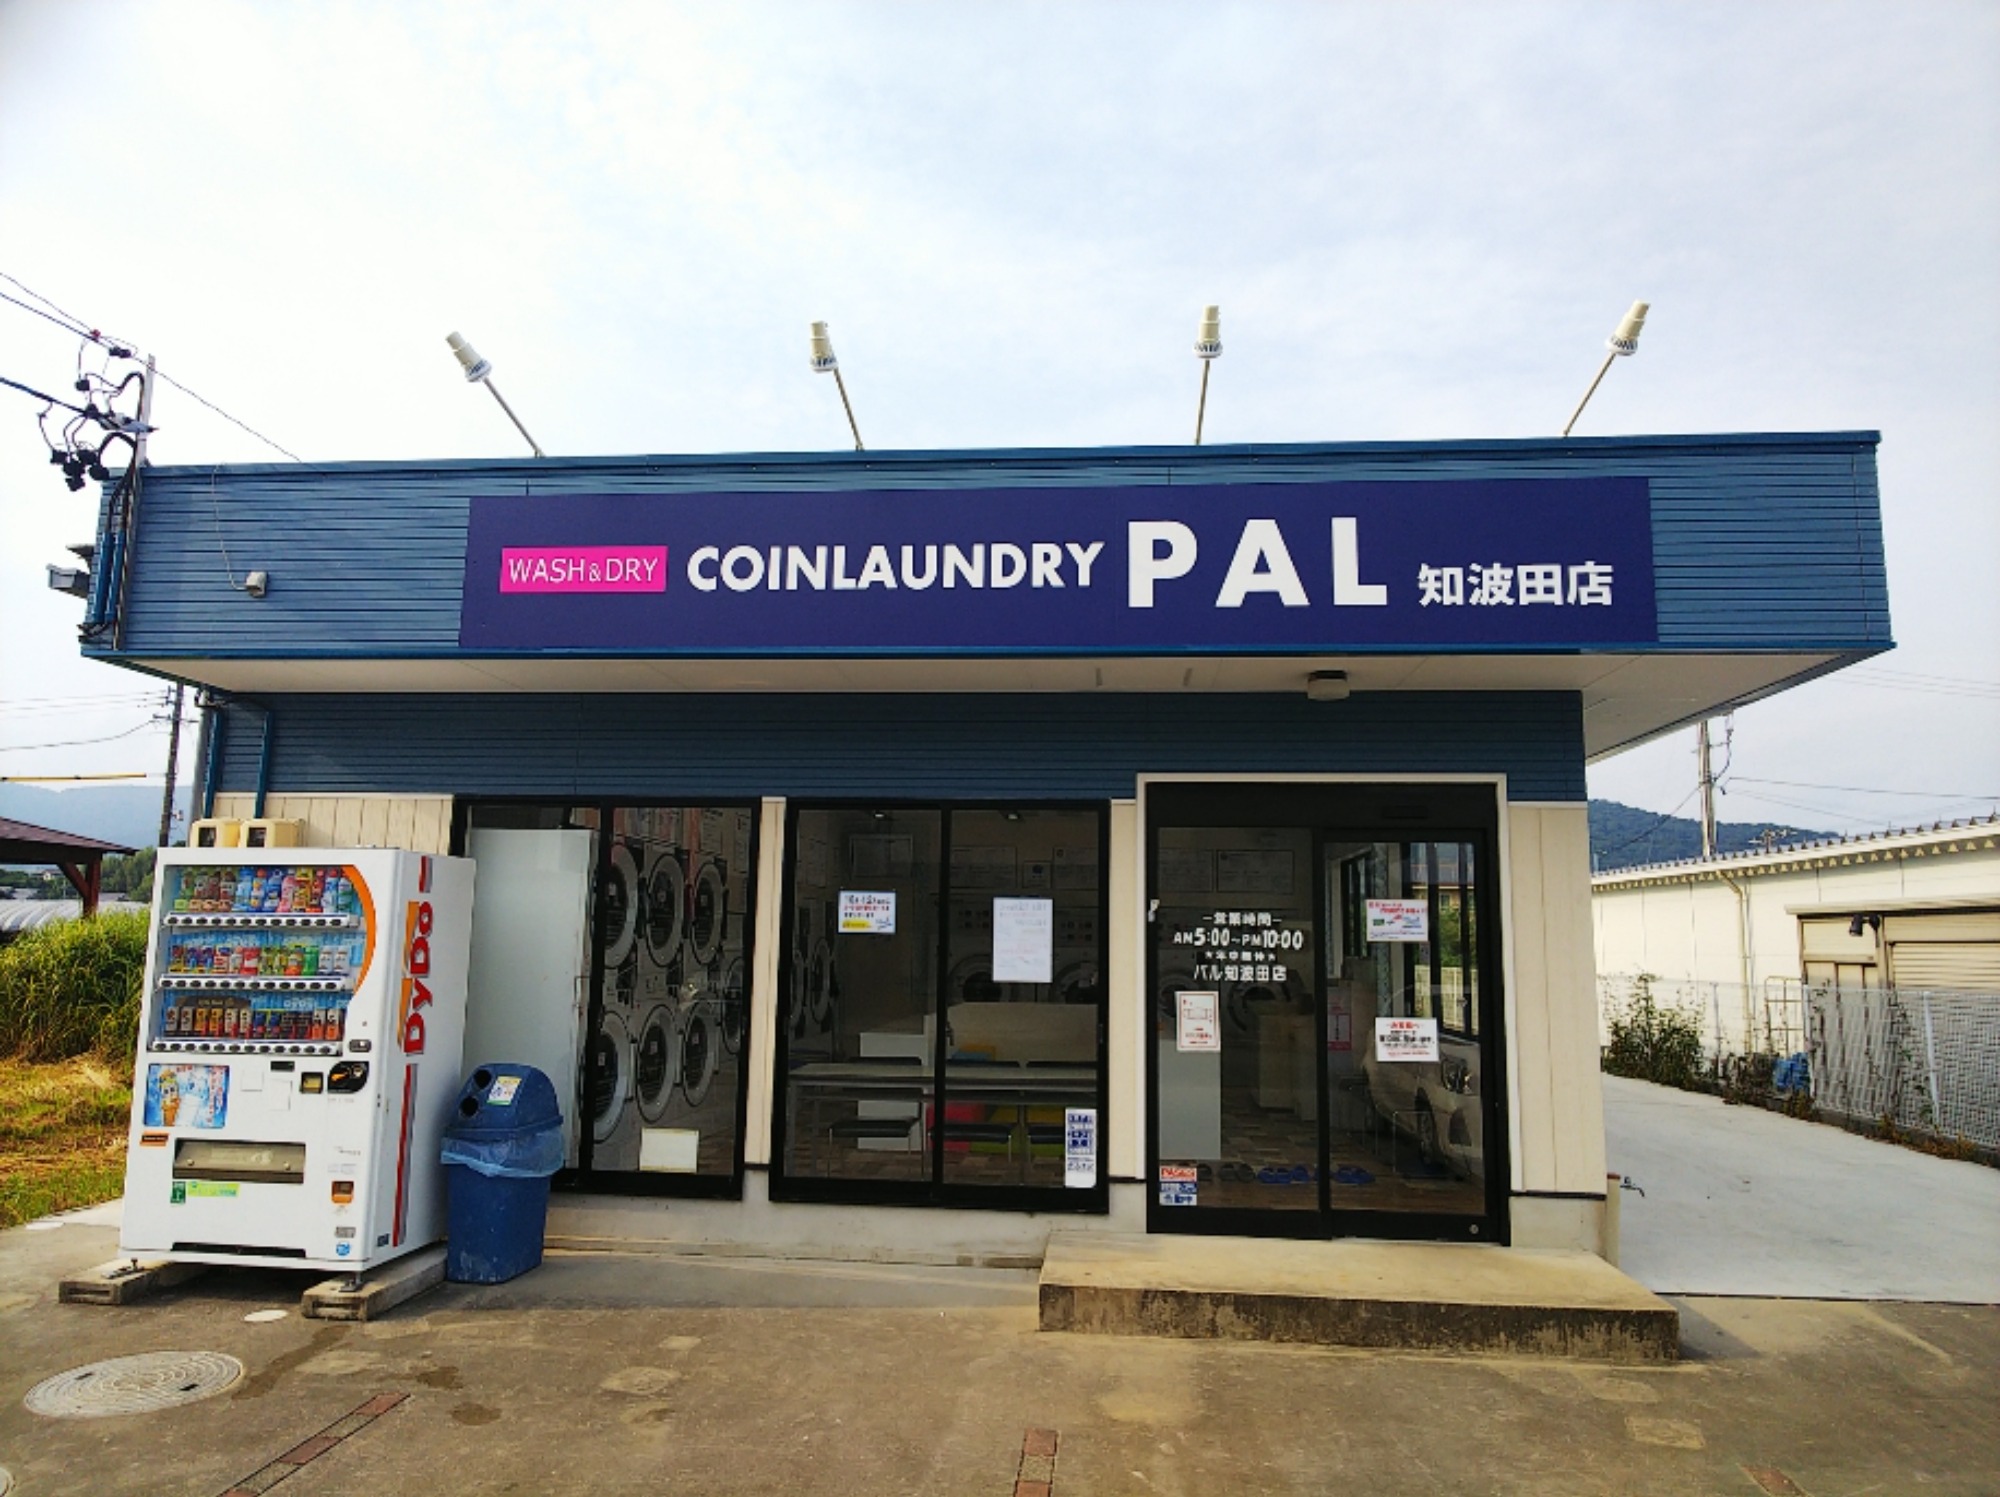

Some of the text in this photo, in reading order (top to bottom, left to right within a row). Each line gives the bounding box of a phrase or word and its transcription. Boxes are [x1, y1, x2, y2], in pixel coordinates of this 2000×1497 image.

[508, 557, 659, 584] WASH&DRY
[687, 516, 1614, 608] COINLAUNDRY PAL 知波田店
[404, 901, 433, 1054] DyDo
